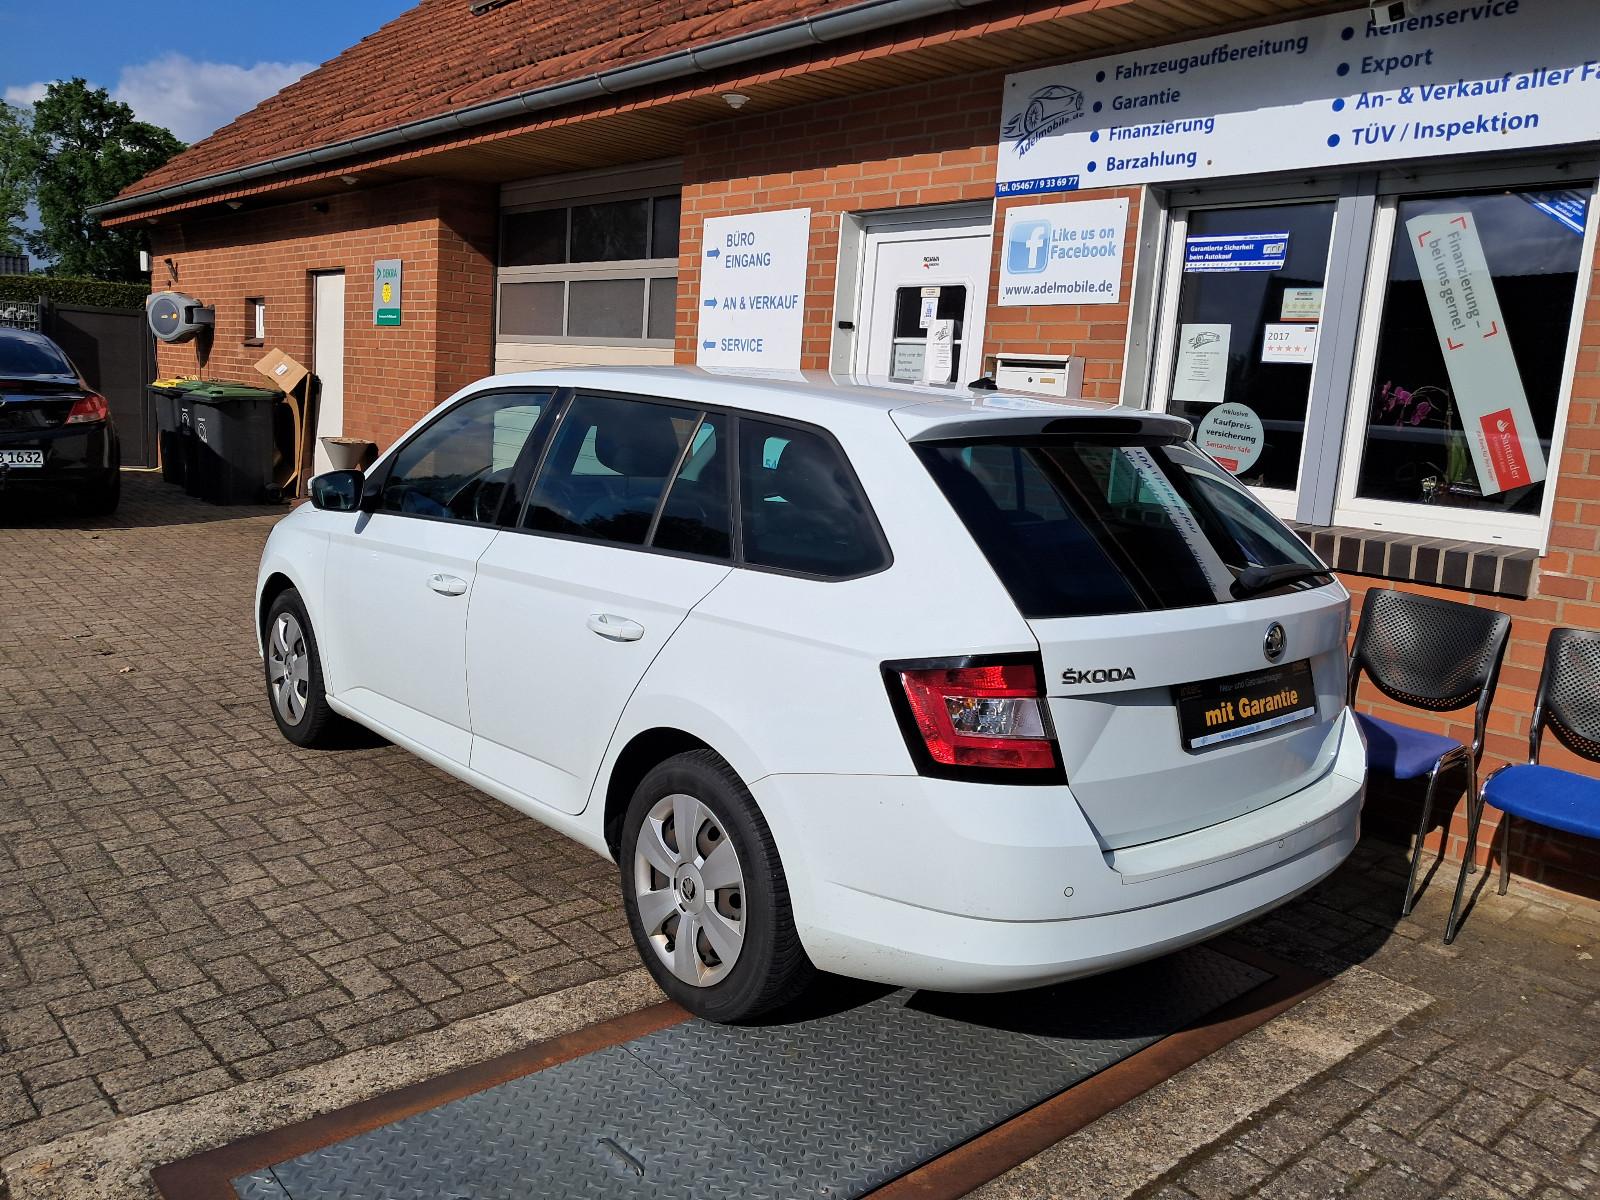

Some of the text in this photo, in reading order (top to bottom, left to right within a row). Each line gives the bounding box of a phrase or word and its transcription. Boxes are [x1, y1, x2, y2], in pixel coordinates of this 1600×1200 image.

[1115, 35, 1309, 81] Fahrzeugaufbereitung
[1361, 49, 1434, 75] Export
[1355, 91, 1393, 110] An-
[1398, 86, 1415, 105] &
[1420, 71, 1513, 102] Verkauf
[1516, 66, 1574, 91] aller
[1112, 87, 1181, 111] Garantie
[1019, 111, 1085, 159] Adelmobile.de
[1109, 116, 1215, 142] Finanzierung
[1352, 111, 1539, 146] TÜV / Inspektion
[1106, 150, 1197, 172] Barzahlung
[997, 182, 1010, 193] Tel.
[1011, 180, 1035, 191] 05467
[1040, 180, 1045, 189] 9
[1045, 178, 1055, 188] 33
[1056, 177, 1067, 187] 69
[1068, 176, 1079, 186] 77
[726, 231, 755, 248] BÜRO
[1052, 227, 1115, 242] Like us on
[1050, 241, 1117, 259] Facebook
[1190, 244, 1223, 252] Garantierte
[1223, 243, 1255, 251] Sicherheit
[1204, 252, 1233, 260] Autokauf
[725, 252, 771, 269] EINGANG
[1448, 230, 1480, 320] Finanzierung
[1005, 280, 1113, 295] www.adelmobile.de
[1429, 238, 1466, 331] bei uns gerne!
[722, 295, 799, 310] AN & VERKAUF
[721, 338, 764, 352] SERVICE
[1268, 332, 1290, 341] 2017
[1213, 417, 1253, 430] Kaufpreis-
[1206, 429, 1257, 445] versicherung
[8, 452, 42, 463] 1632
[1500, 432, 1521, 479] Santander
[1062, 667, 1136, 685] ŠKODA
[1205, 701, 1235, 727] mit
[1238, 687, 1299, 718] Garantie
